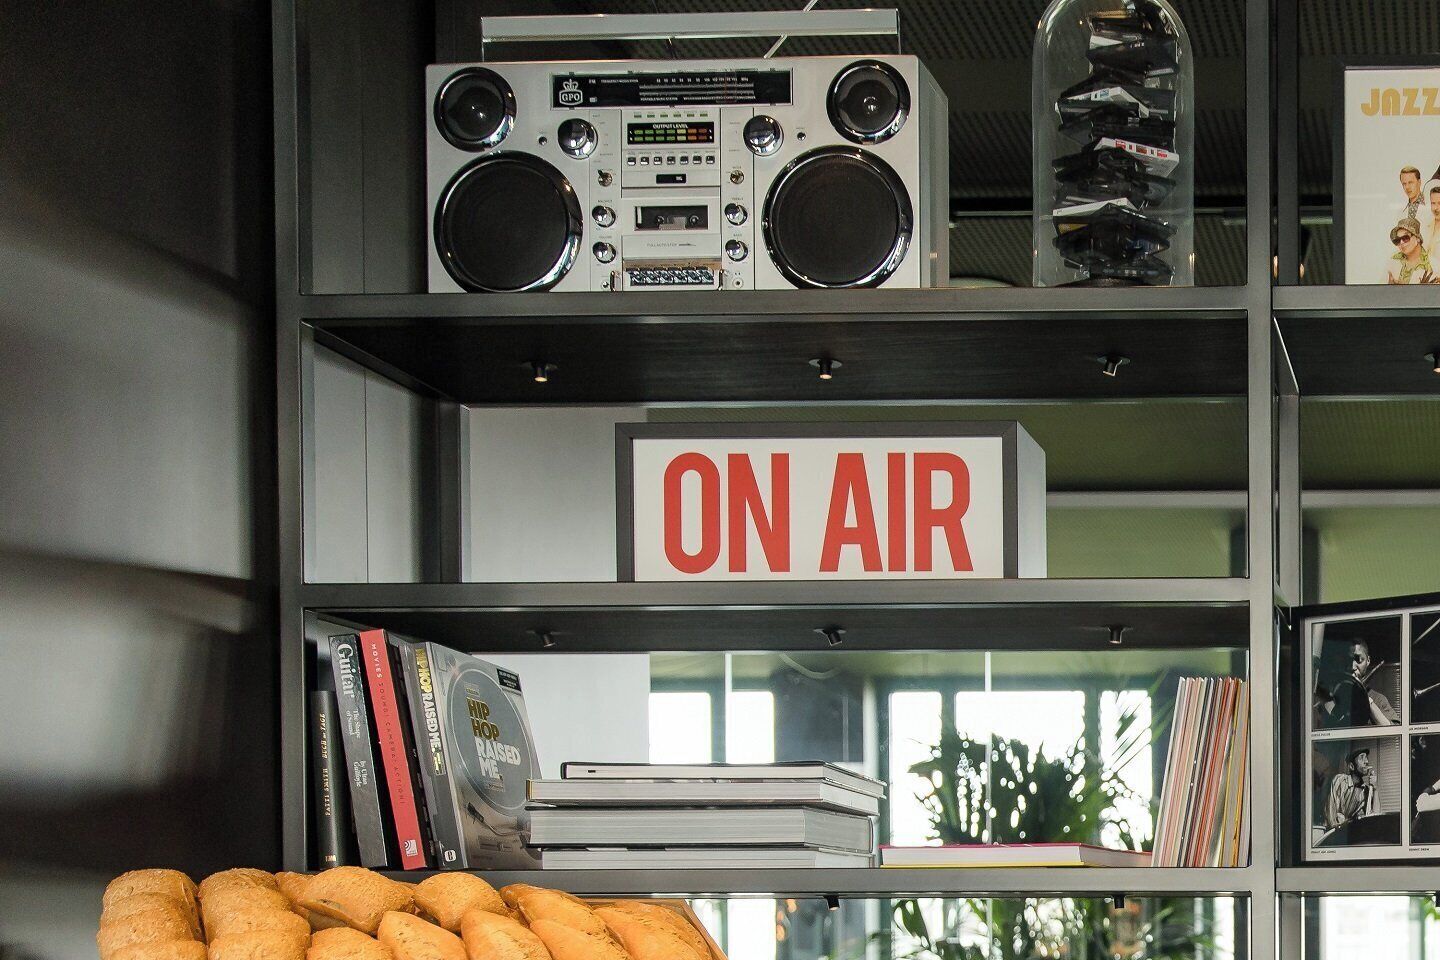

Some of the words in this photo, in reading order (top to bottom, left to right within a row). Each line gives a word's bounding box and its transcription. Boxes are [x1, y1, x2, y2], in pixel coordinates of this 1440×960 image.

[562, 93, 580, 102] GPO
[663, 452, 791, 575] ON
[818, 452, 974, 573] AIR
[337, 643, 357, 698] Guitar
[371, 643, 383, 679] MOVIES
[418, 668, 433, 693] HOP
[422, 693, 438, 733] RAISED
[466, 697, 490, 720] HIP
[470, 717, 500, 741] HOP
[475, 736, 521, 766] RAISED
[322, 768, 330, 791] SMITH
[479, 756, 504, 781] ME.
[324, 793, 332, 816] PATTI
